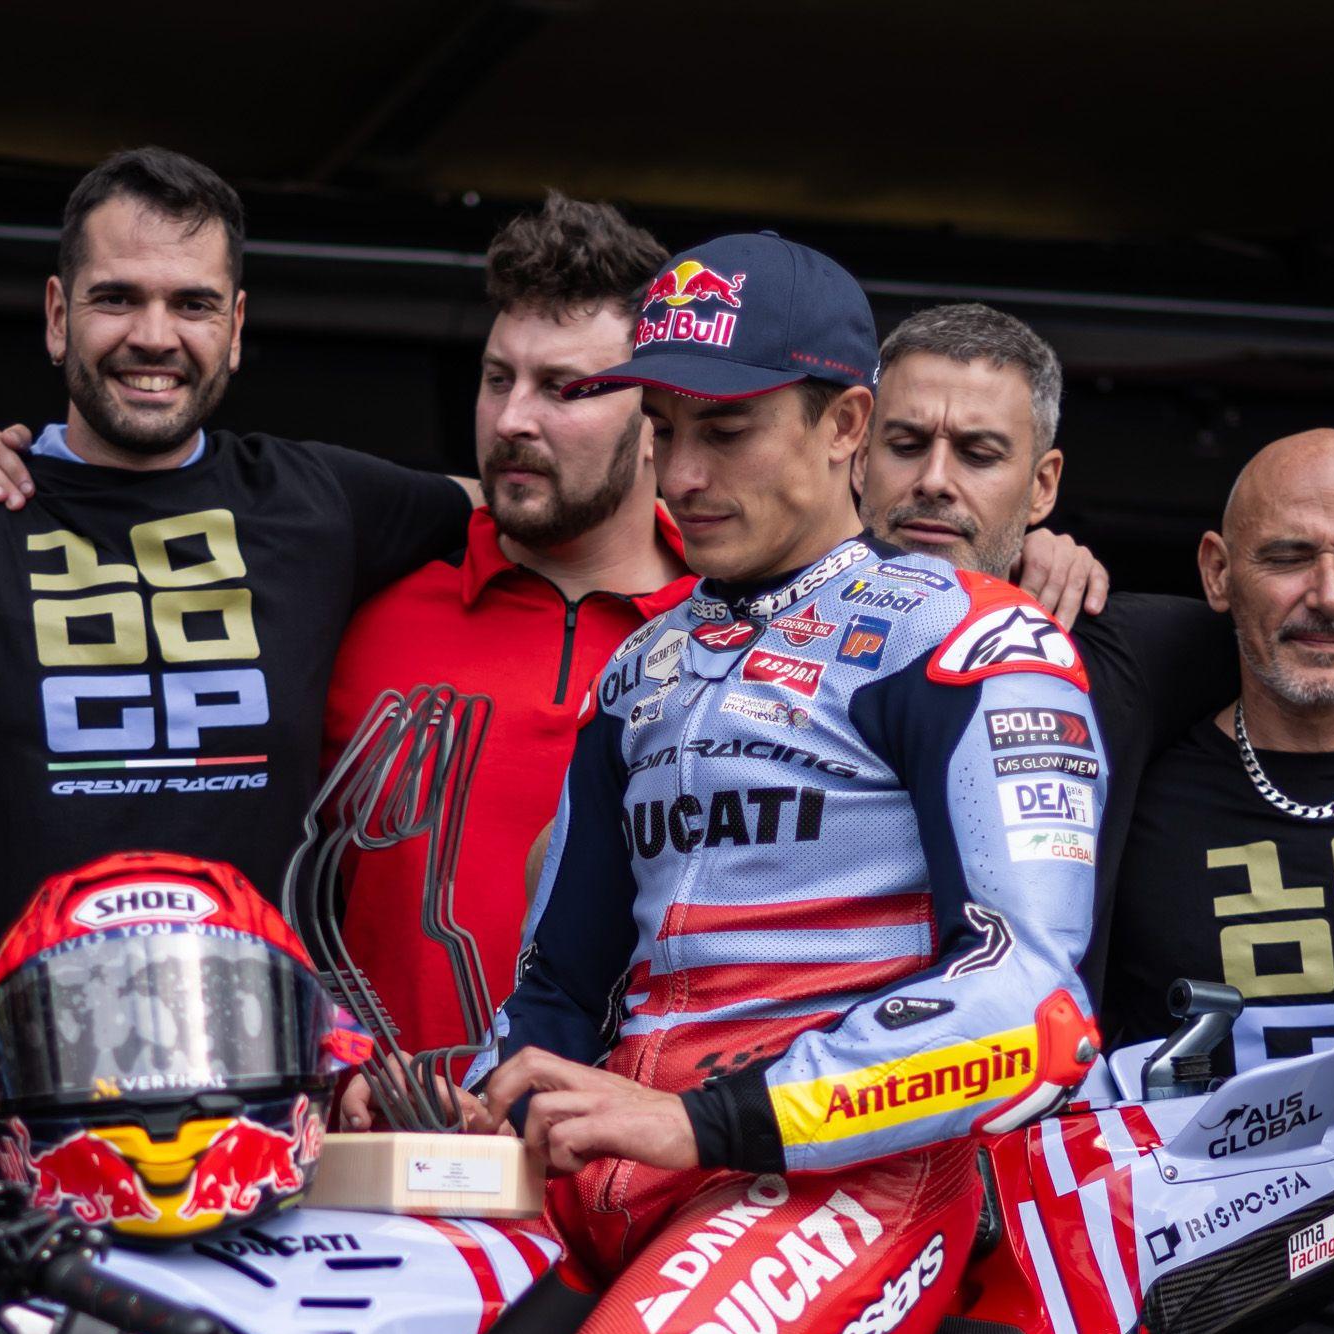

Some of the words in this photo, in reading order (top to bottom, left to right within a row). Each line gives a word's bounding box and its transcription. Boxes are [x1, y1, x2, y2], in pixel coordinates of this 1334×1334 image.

[635, 308, 673, 350] Red
[672, 309, 736, 347] Bull
[27, 508, 247, 592] 10
[750, 541, 869, 620] alpinestars
[839, 579, 925, 614] Unibat
[33, 588, 261, 666] 00
[773, 618, 812, 632] FEDERAL
[814, 625, 830, 635] OIL
[842, 628, 885, 655] IP
[602, 654, 642, 708] OLI
[754, 658, 818, 684] ASPIRA
[42, 668, 269, 752] GP
[990, 712, 1056, 735] BOLD
[995, 733, 1060, 745] RIDERS
[683, 739, 859, 779] RACING
[997, 758, 1020, 773] MS
[1022, 756, 1065, 769] GLOW
[1068, 759, 1097, 775] MEN
[51, 779, 161, 795] GRESINI
[165, 772, 268, 793] RACING
[1051, 845, 1094, 864] GLOBAL
[1053, 832, 1079, 845] AUS
[94, 890, 196, 919] SHOEI
[38, 931, 108, 962] GIVES
[120, 922, 172, 939] YOU
[185, 922, 267, 949] WINGS
[122, 1074, 227, 1091] VERTICAL
[824, 1043, 1032, 1123] Antangin
[1242, 1091, 1303, 1130] AUS
[1208, 1104, 1323, 1160] GLOBAL
[657, 1172, 790, 1290] DAIKO
[1289, 1222, 1325, 1255] uma
